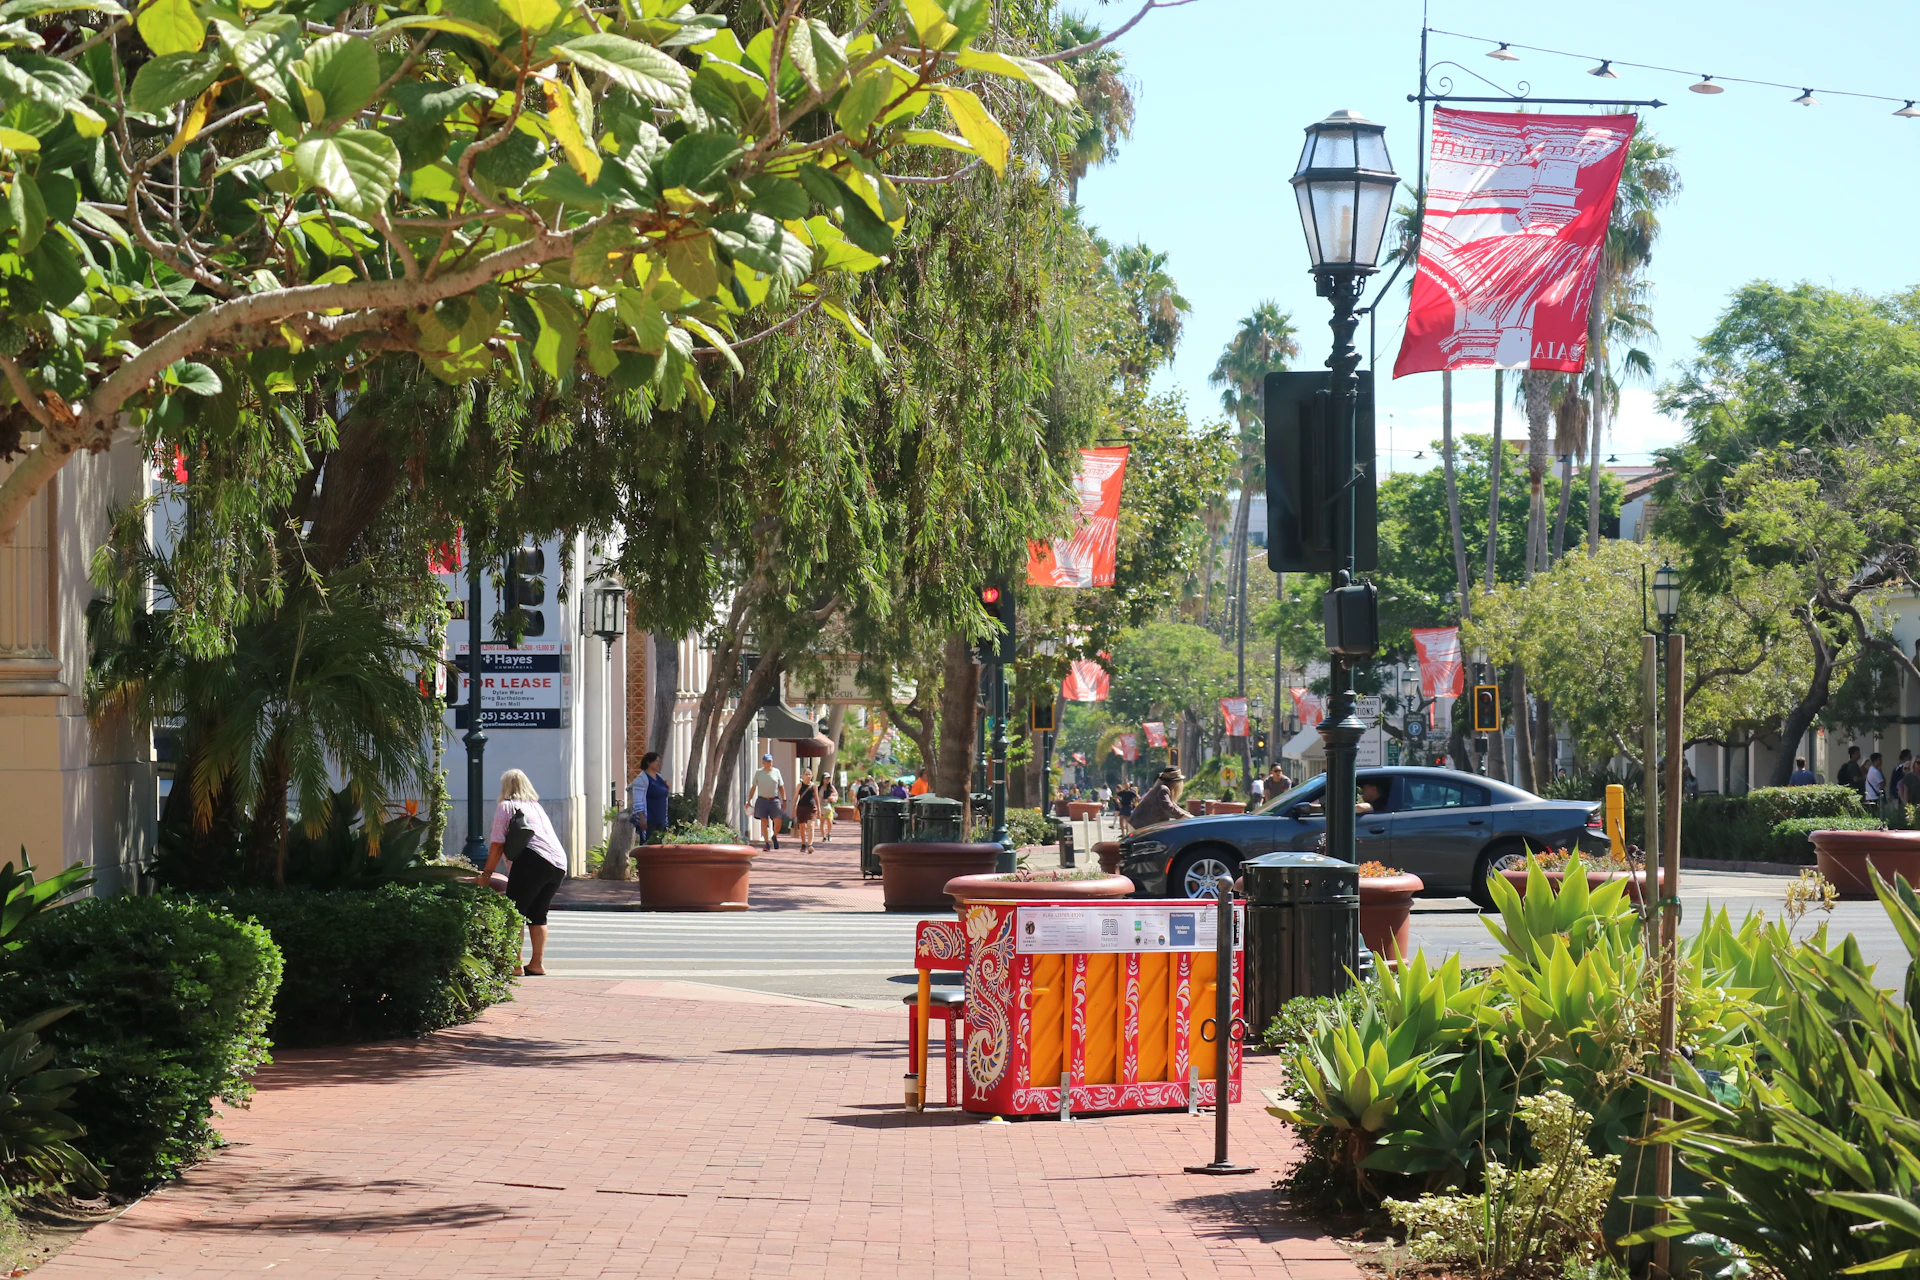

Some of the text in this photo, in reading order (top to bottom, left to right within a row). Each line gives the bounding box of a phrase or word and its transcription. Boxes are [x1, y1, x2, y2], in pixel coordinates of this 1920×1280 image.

[495, 655, 533, 666] Hayes
[463, 678, 552, 688] FR LEASE
[500, 711, 546, 720] 563-2111
[1412, 724, 1419, 733] P
